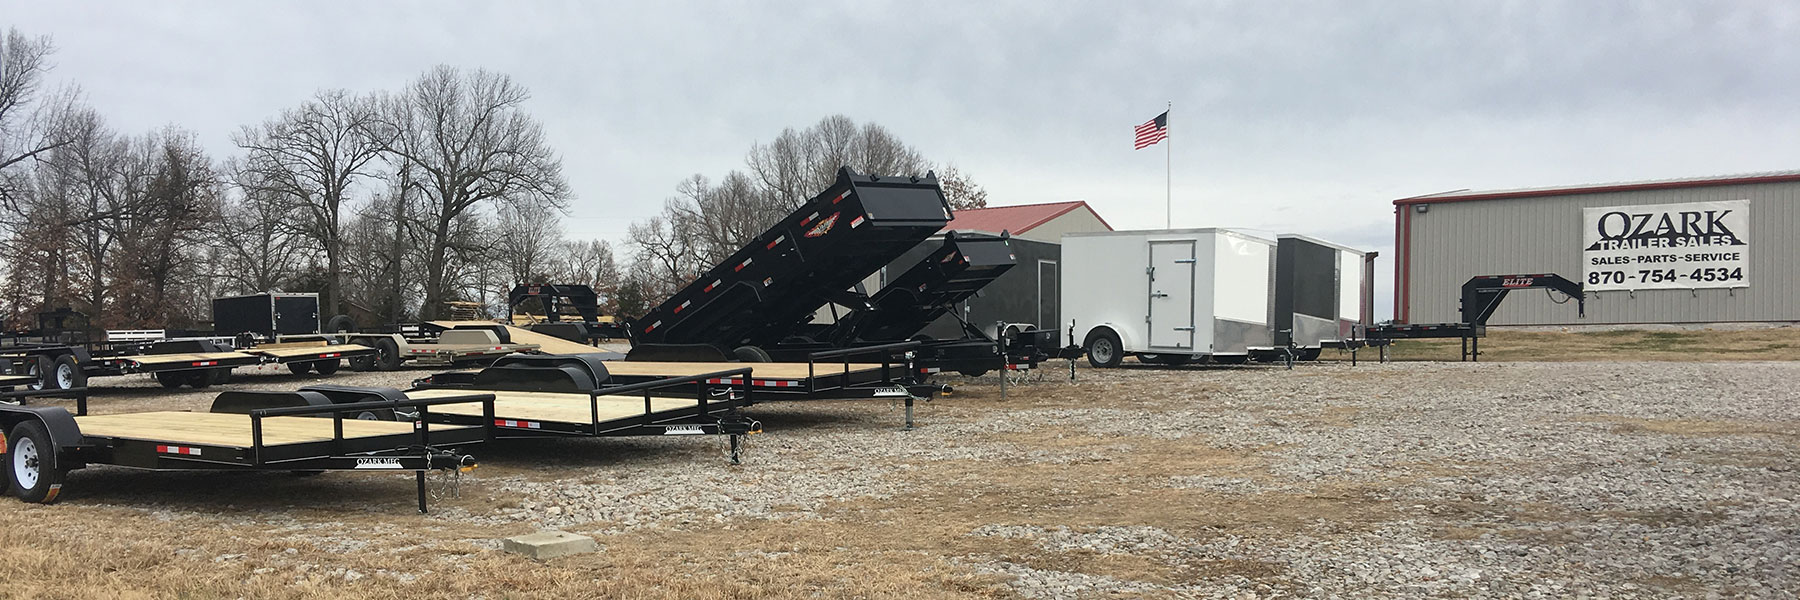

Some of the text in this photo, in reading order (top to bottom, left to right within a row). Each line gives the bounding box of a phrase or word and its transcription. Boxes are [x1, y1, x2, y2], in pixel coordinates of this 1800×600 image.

[1597, 210, 1733, 240] OZARK
[1599, 235, 1732, 250] TRAILER SALES
[1502, 277, 1534, 286] ELITE
